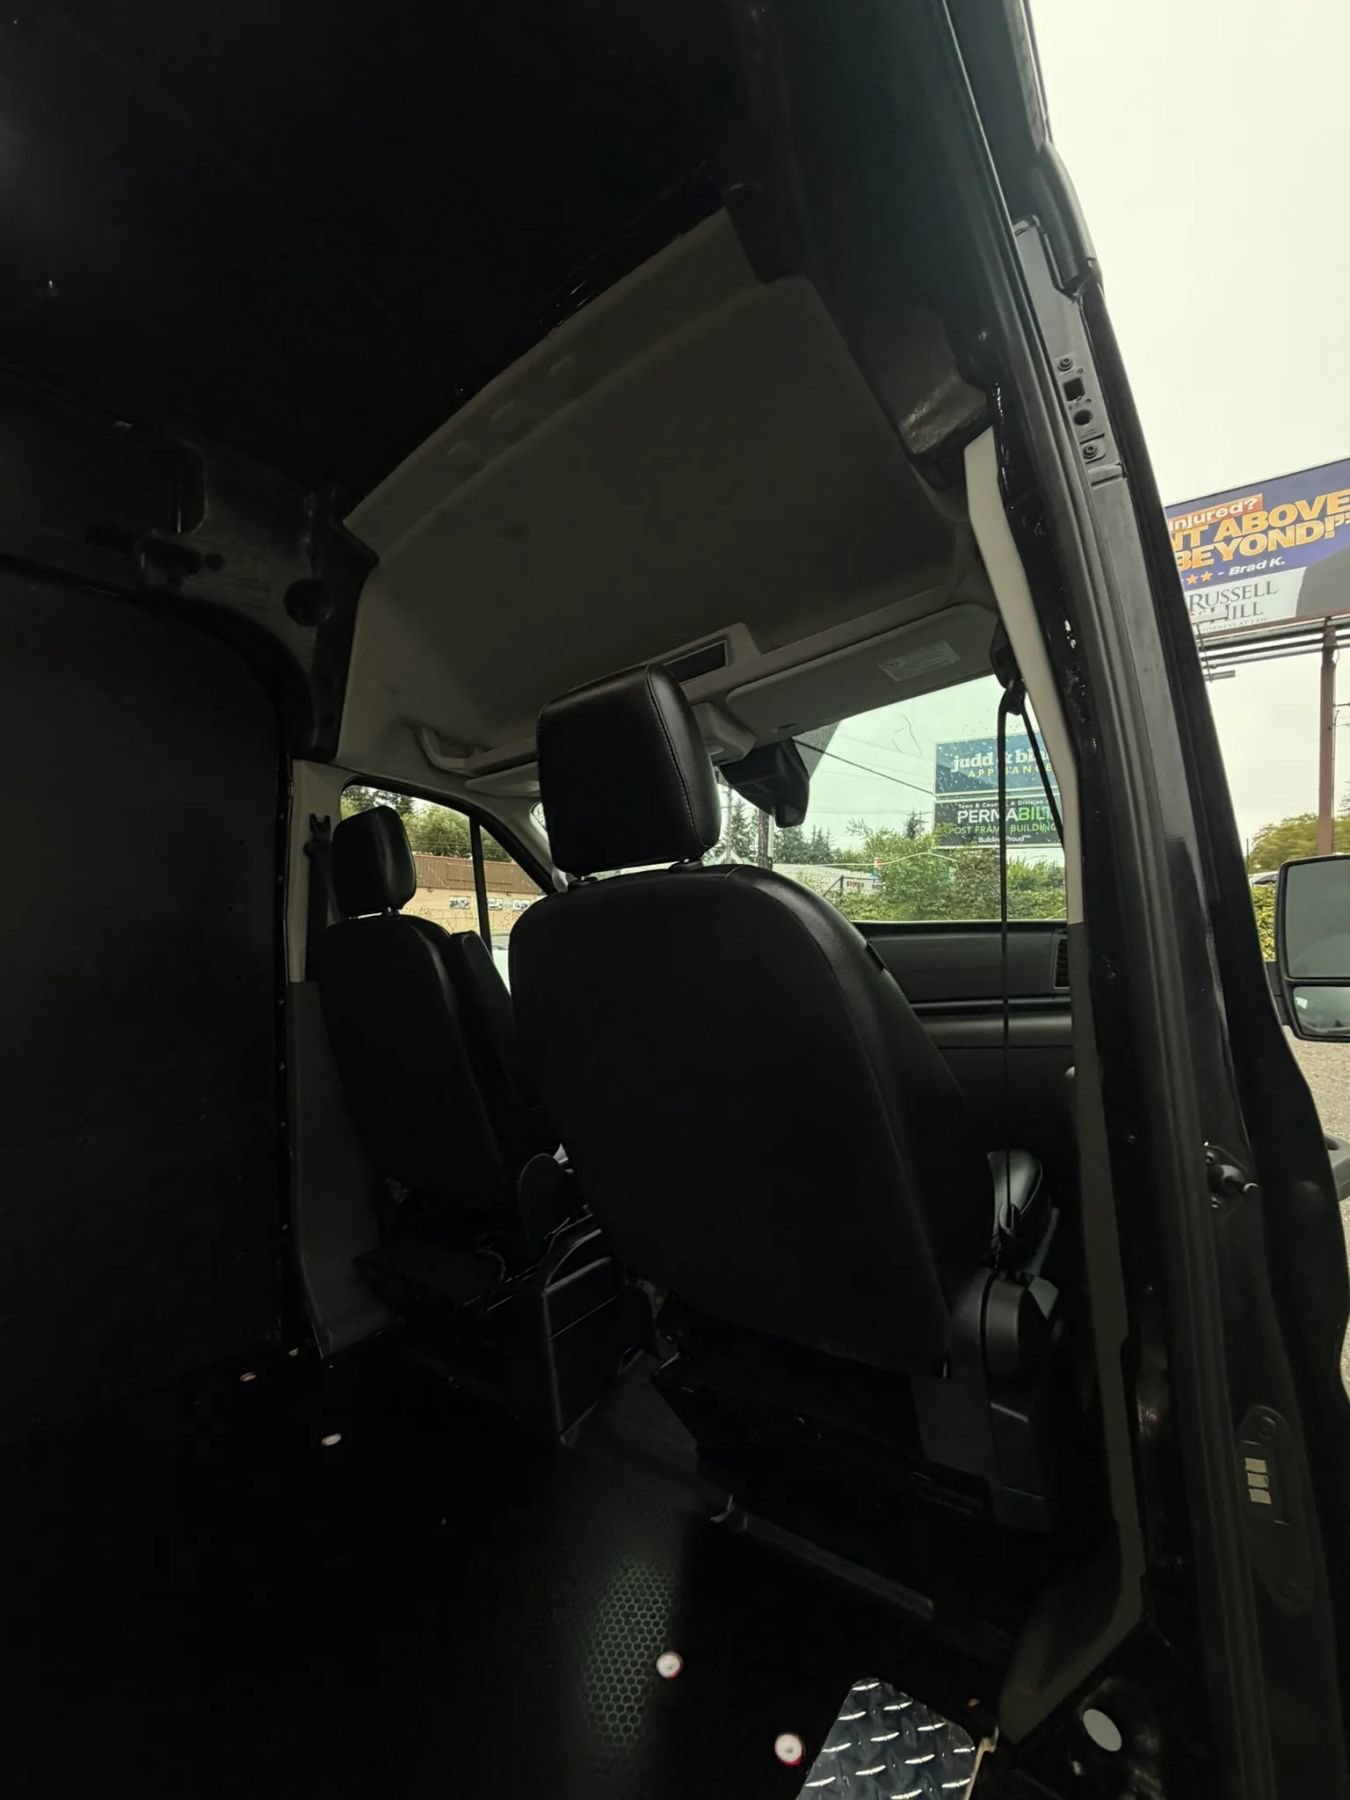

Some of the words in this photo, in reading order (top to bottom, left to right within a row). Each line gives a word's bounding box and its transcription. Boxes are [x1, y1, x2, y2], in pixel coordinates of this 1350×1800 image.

[1213, 488, 1350, 542] ABOVE
[1228, 560, 1267, 577] Brad
[1269, 556, 1286, 568] K.
[1188, 581, 1278, 611] RUSSELL
[951, 751, 994, 773] judd
[975, 825, 1001, 833] FRAM
